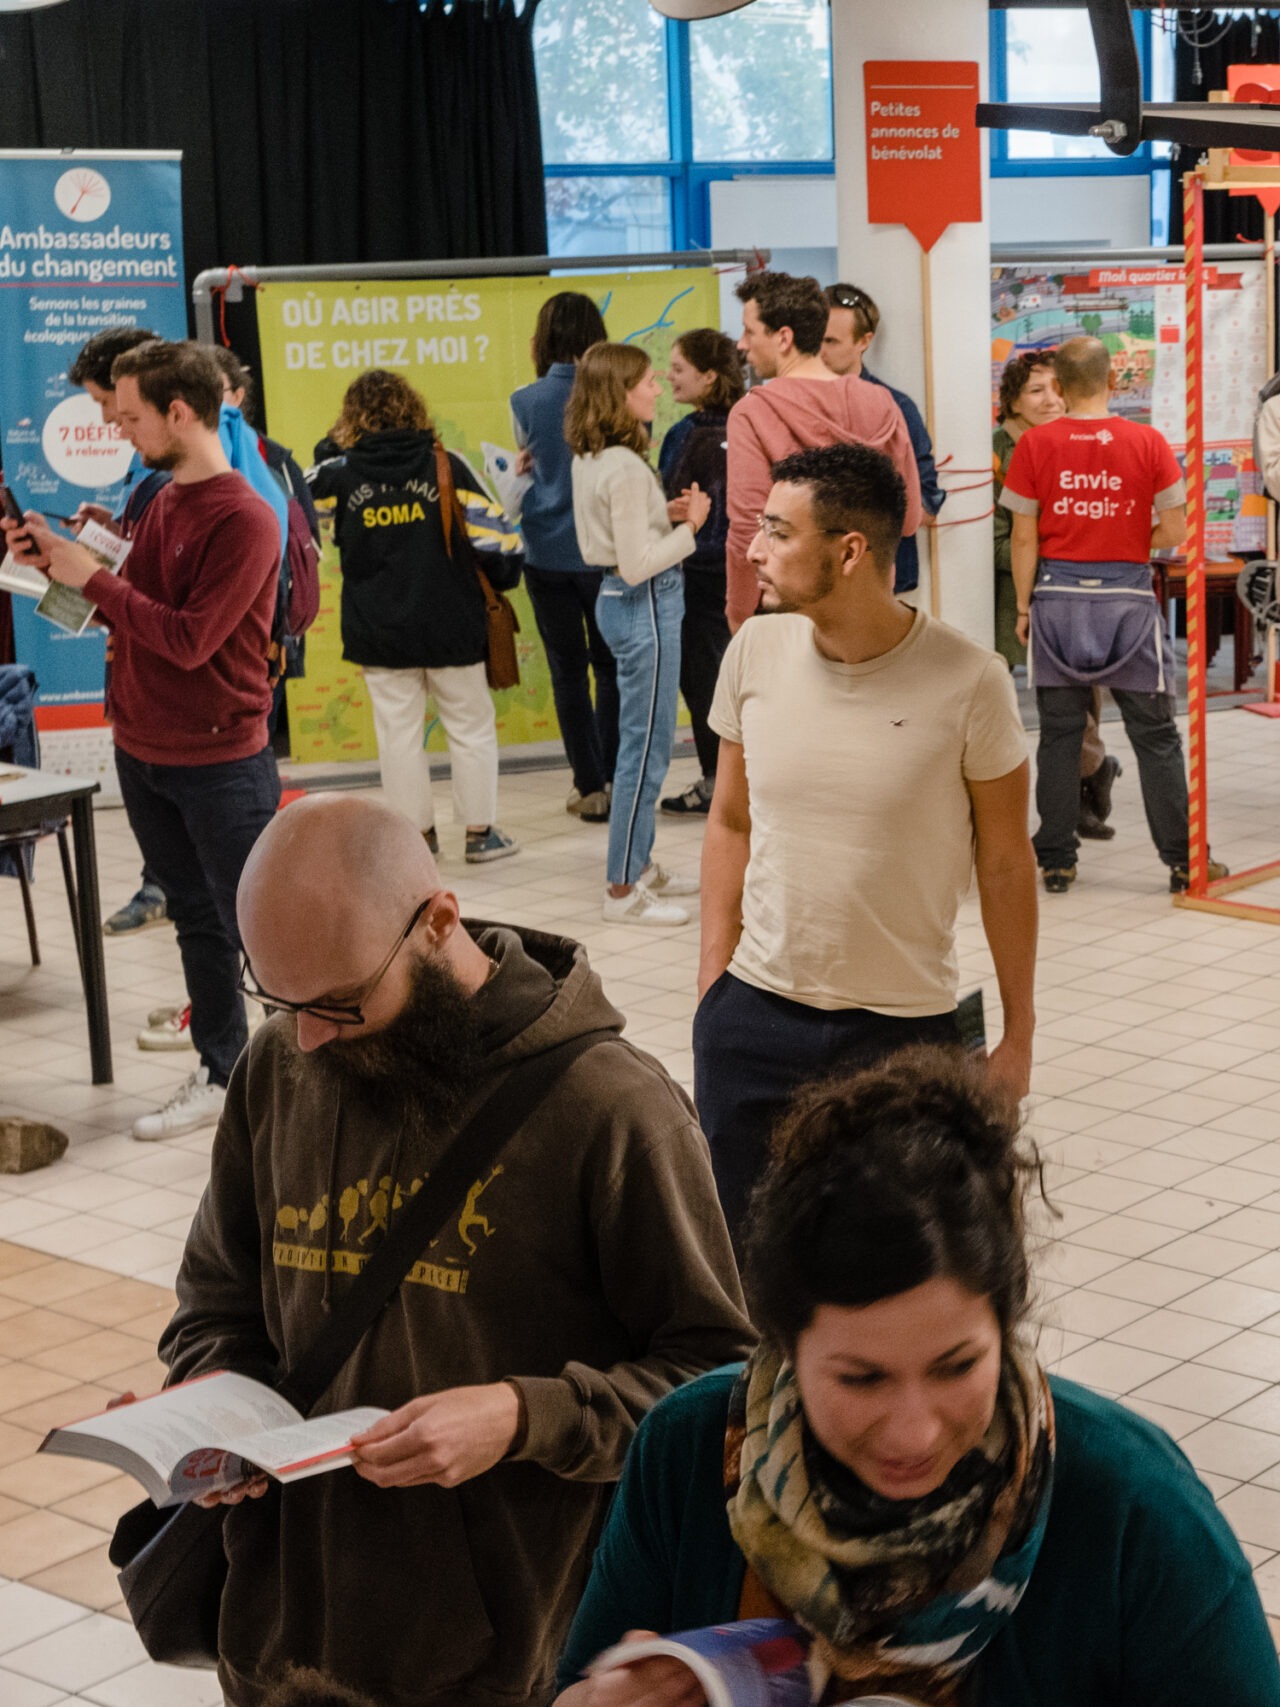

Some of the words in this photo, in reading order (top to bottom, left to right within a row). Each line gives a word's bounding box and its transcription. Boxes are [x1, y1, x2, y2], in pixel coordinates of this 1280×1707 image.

[870, 101, 921, 116] Petites
[871, 127, 939, 138] annonces
[942, 123, 960, 138] de
[871, 145, 943, 160] bénévolat
[0, 224, 171, 250] Ambassadeurs
[0, 252, 26, 277] du
[32, 252, 177, 283] changement
[1098, 270, 1127, 282] Mon
[1129, 269, 1176, 284] quartier
[29, 297, 79, 311] Semons
[82, 296, 99, 310] les
[101, 298, 147, 313] graines
[282, 291, 322, 327] OÙ
[331, 296, 399, 326] AGIR
[406, 287, 482, 323] PRÈS
[45, 313, 61, 326] de
[63, 313, 75, 326] la
[77, 313, 136, 326] transition
[24, 330, 91, 345] écologique
[285, 342, 326, 369] DE
[331, 338, 410, 368] CHEZ
[416, 335, 468, 364] MOI
[474, 334, 489, 362] ?
[59, 427, 70, 442] 7
[66, 446, 73, 457] à
[76, 447, 119, 456] relever
[1059, 469, 1123, 491] Envie
[362, 501, 426, 528] SOMA
[1053, 496, 1120, 519] d'agir
[1124, 499, 1135, 516] ?
